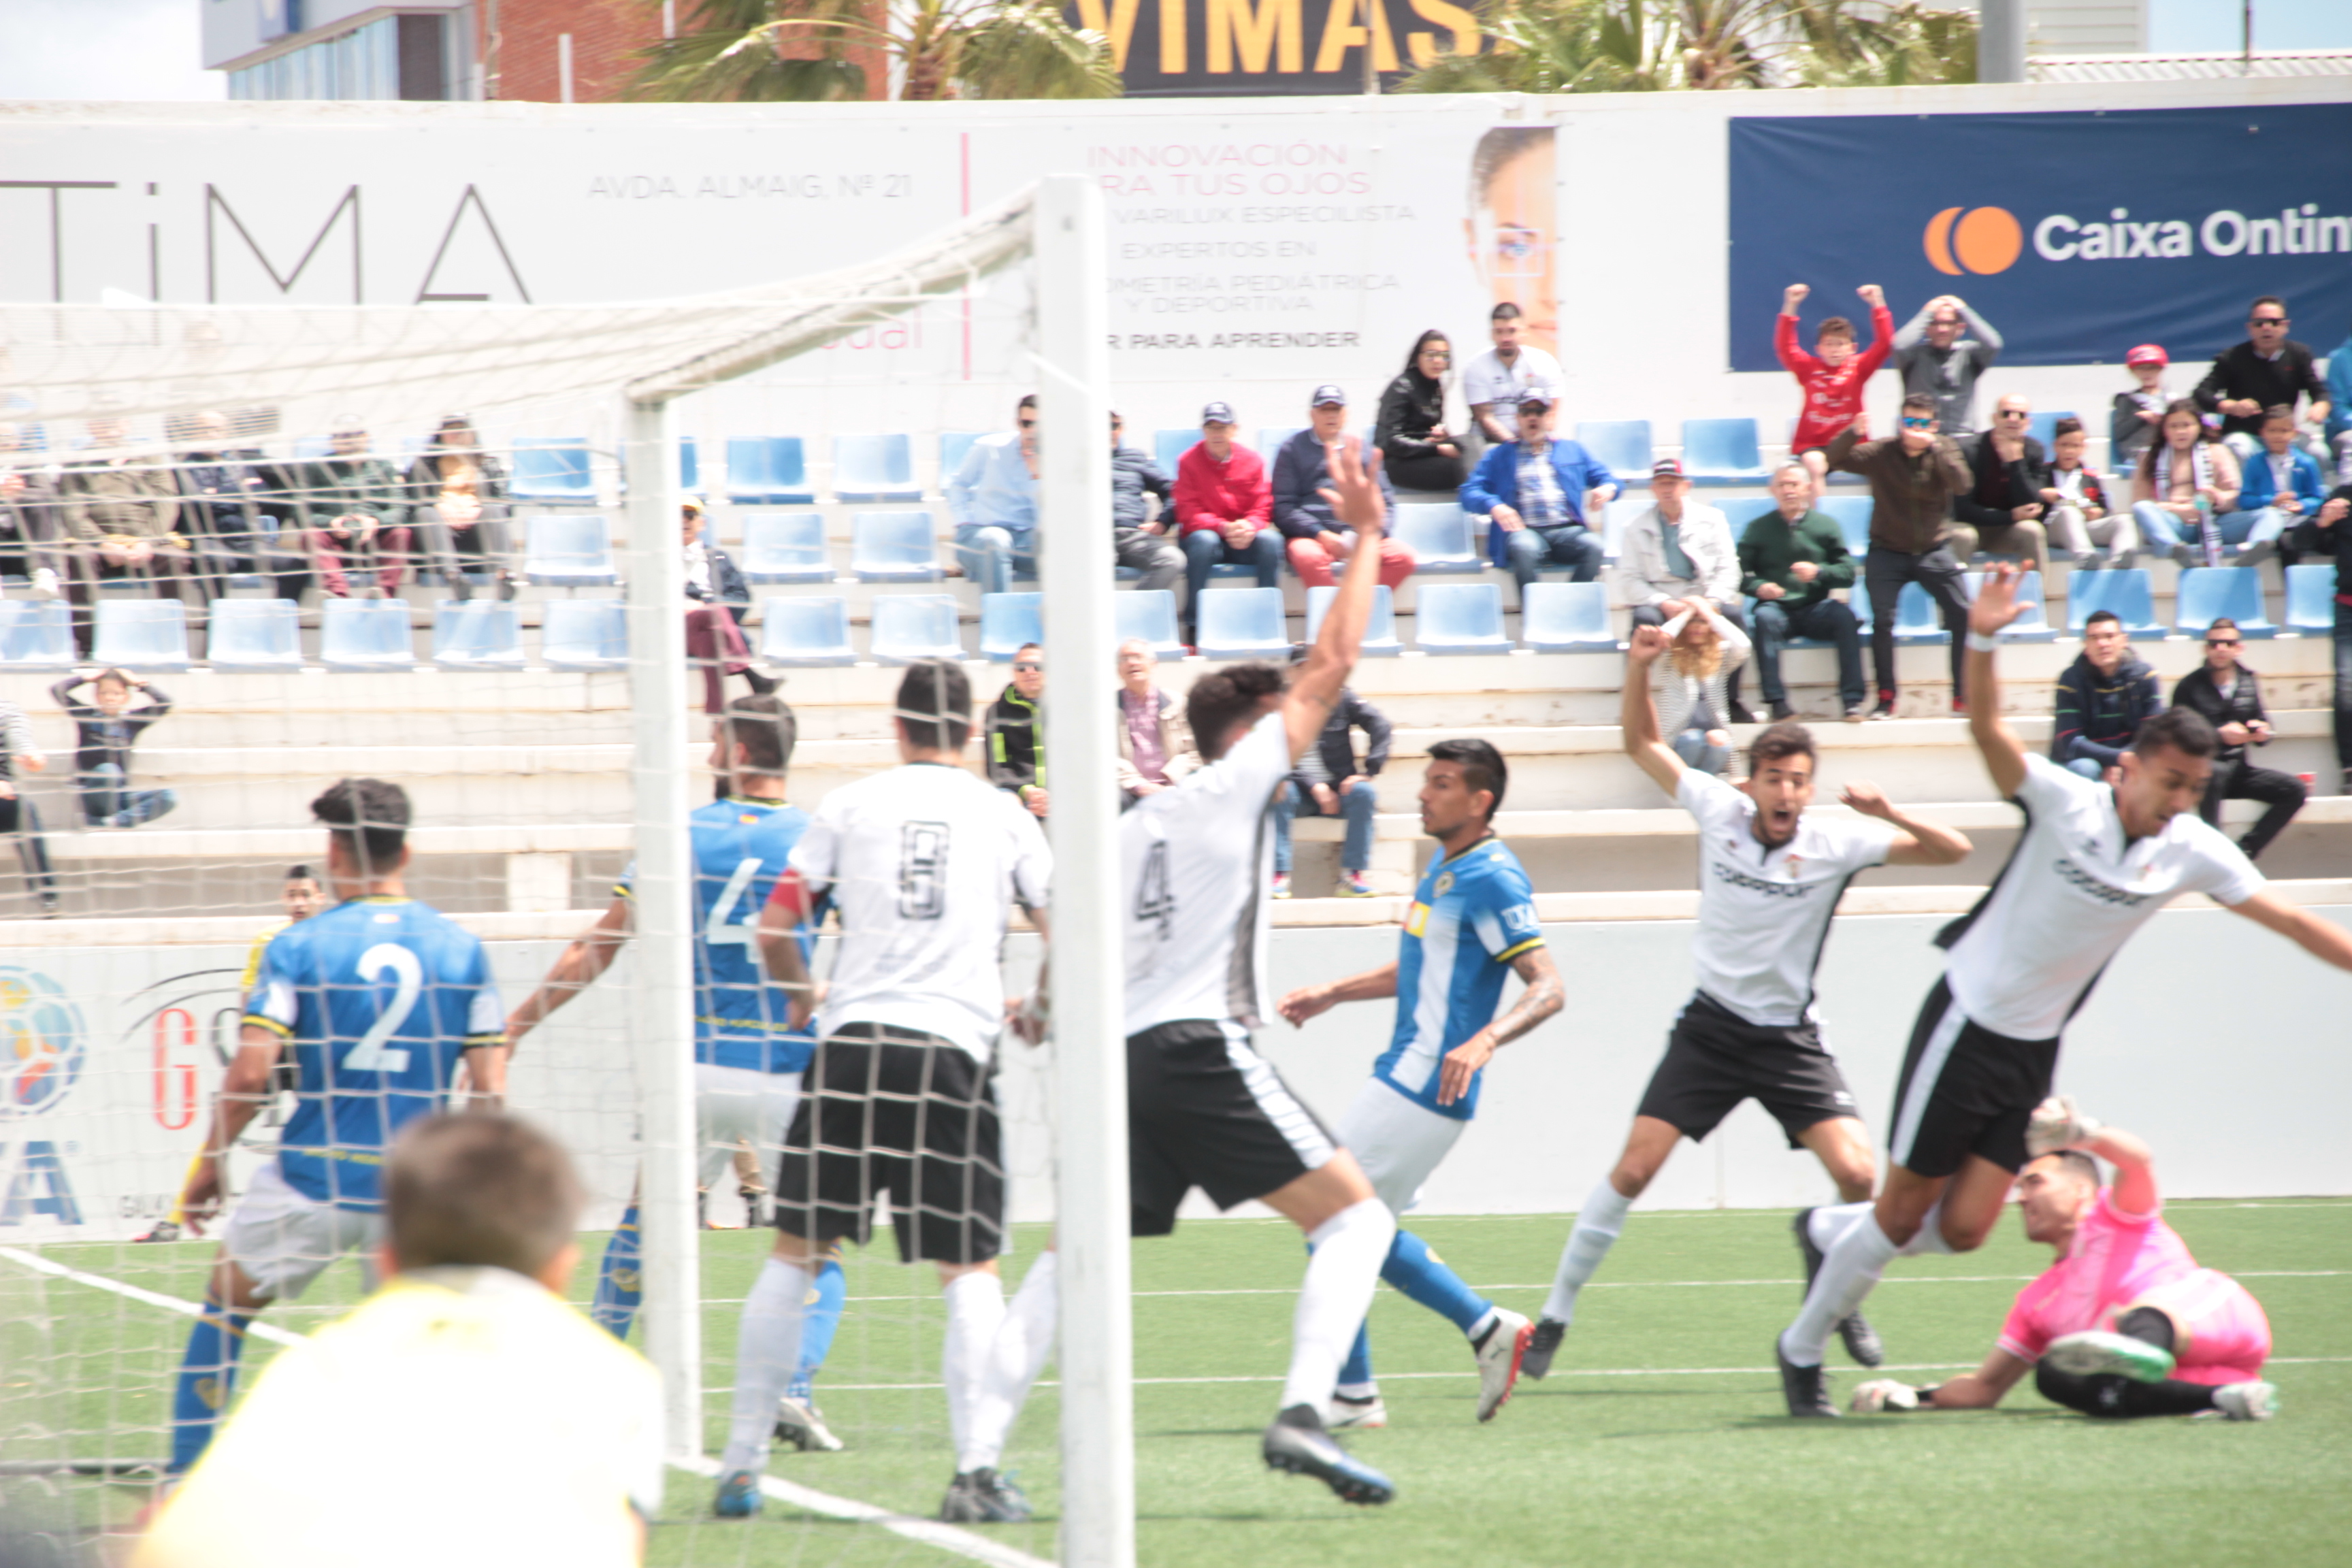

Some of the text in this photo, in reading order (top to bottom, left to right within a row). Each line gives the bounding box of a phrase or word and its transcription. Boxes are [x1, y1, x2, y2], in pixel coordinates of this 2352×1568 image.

[1087, 138, 1348, 167] INNOVACIÓN
[881, 174, 913, 198] 21
[1167, 173, 1250, 196] TUS
[1259, 171, 1373, 195] OJOS
[1111, 208, 1236, 225] VARILUX
[2034, 207, 2193, 261] Caixa
[1121, 240, 1318, 259] EXPERTOS EN
[1123, 295, 1316, 314] Y DEPORTIVA
[1128, 333, 1203, 349] PARA
[1207, 331, 1361, 348] APRENDER
[1131, 838, 1176, 942] 4
[341, 943, 422, 1073] 2
